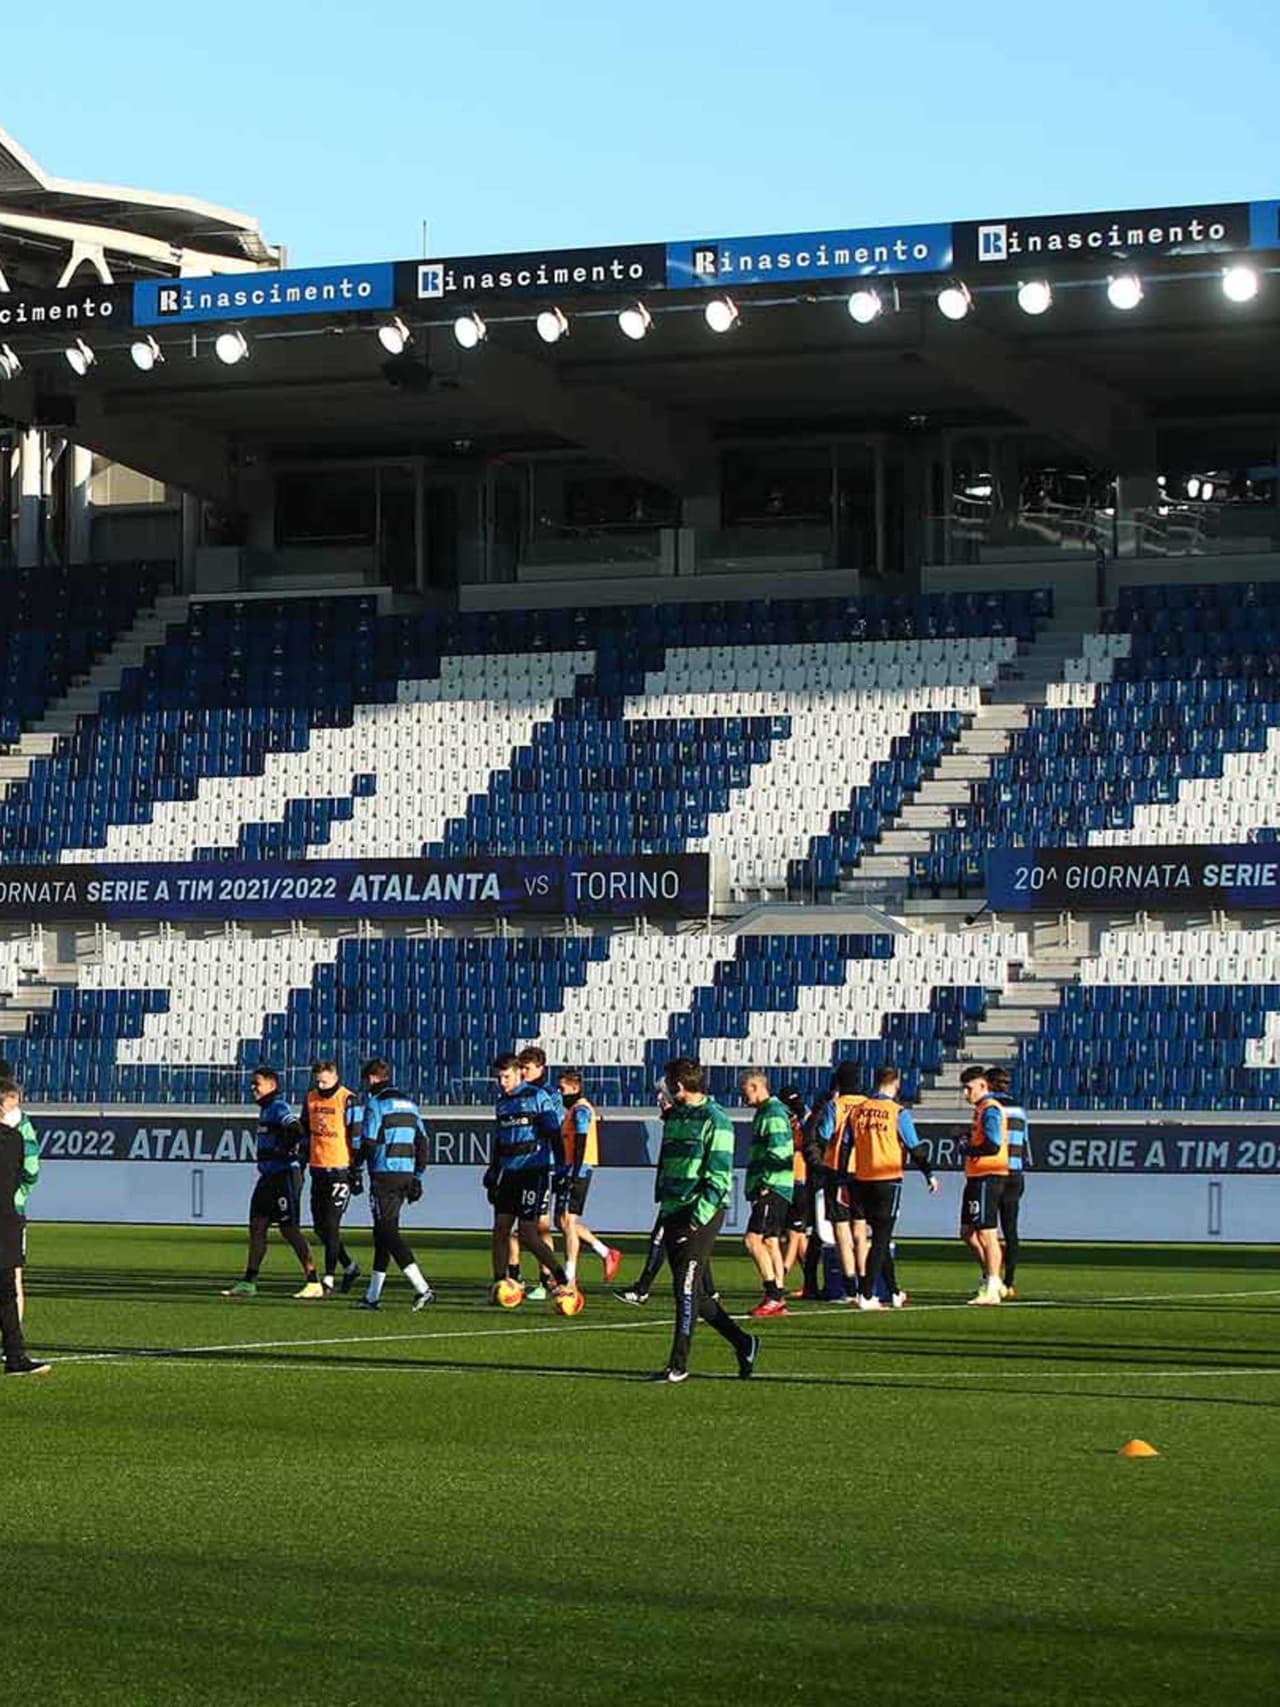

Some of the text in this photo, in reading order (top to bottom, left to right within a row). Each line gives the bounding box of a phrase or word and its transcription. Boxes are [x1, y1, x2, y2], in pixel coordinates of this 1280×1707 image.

[982, 219, 1226, 255] Rinascimento
[695, 241, 929, 273] Rinascimento
[420, 262, 644, 293] Rinascimento
[159, 278, 372, 311] Rinascimento
[86, 880, 149, 901] SERIE
[153, 879, 170, 901] A
[177, 879, 214, 900] TIM
[219, 877, 337, 900] 2021/2022
[349, 873, 501, 901] ATALANTA
[571, 870, 680, 899] TORINO
[1065, 864, 1191, 889] GIORNATA
[1202, 863, 1278, 887] SERIE
[1048, 1139, 1138, 1168] SERIE
[1143, 1140, 1166, 1168] A
[1177, 1141, 1230, 1168] TIM
[1236, 1141, 1280, 1169] 20
[332, 1183, 350, 1199] 72
[521, 1189, 537, 1206] 19
